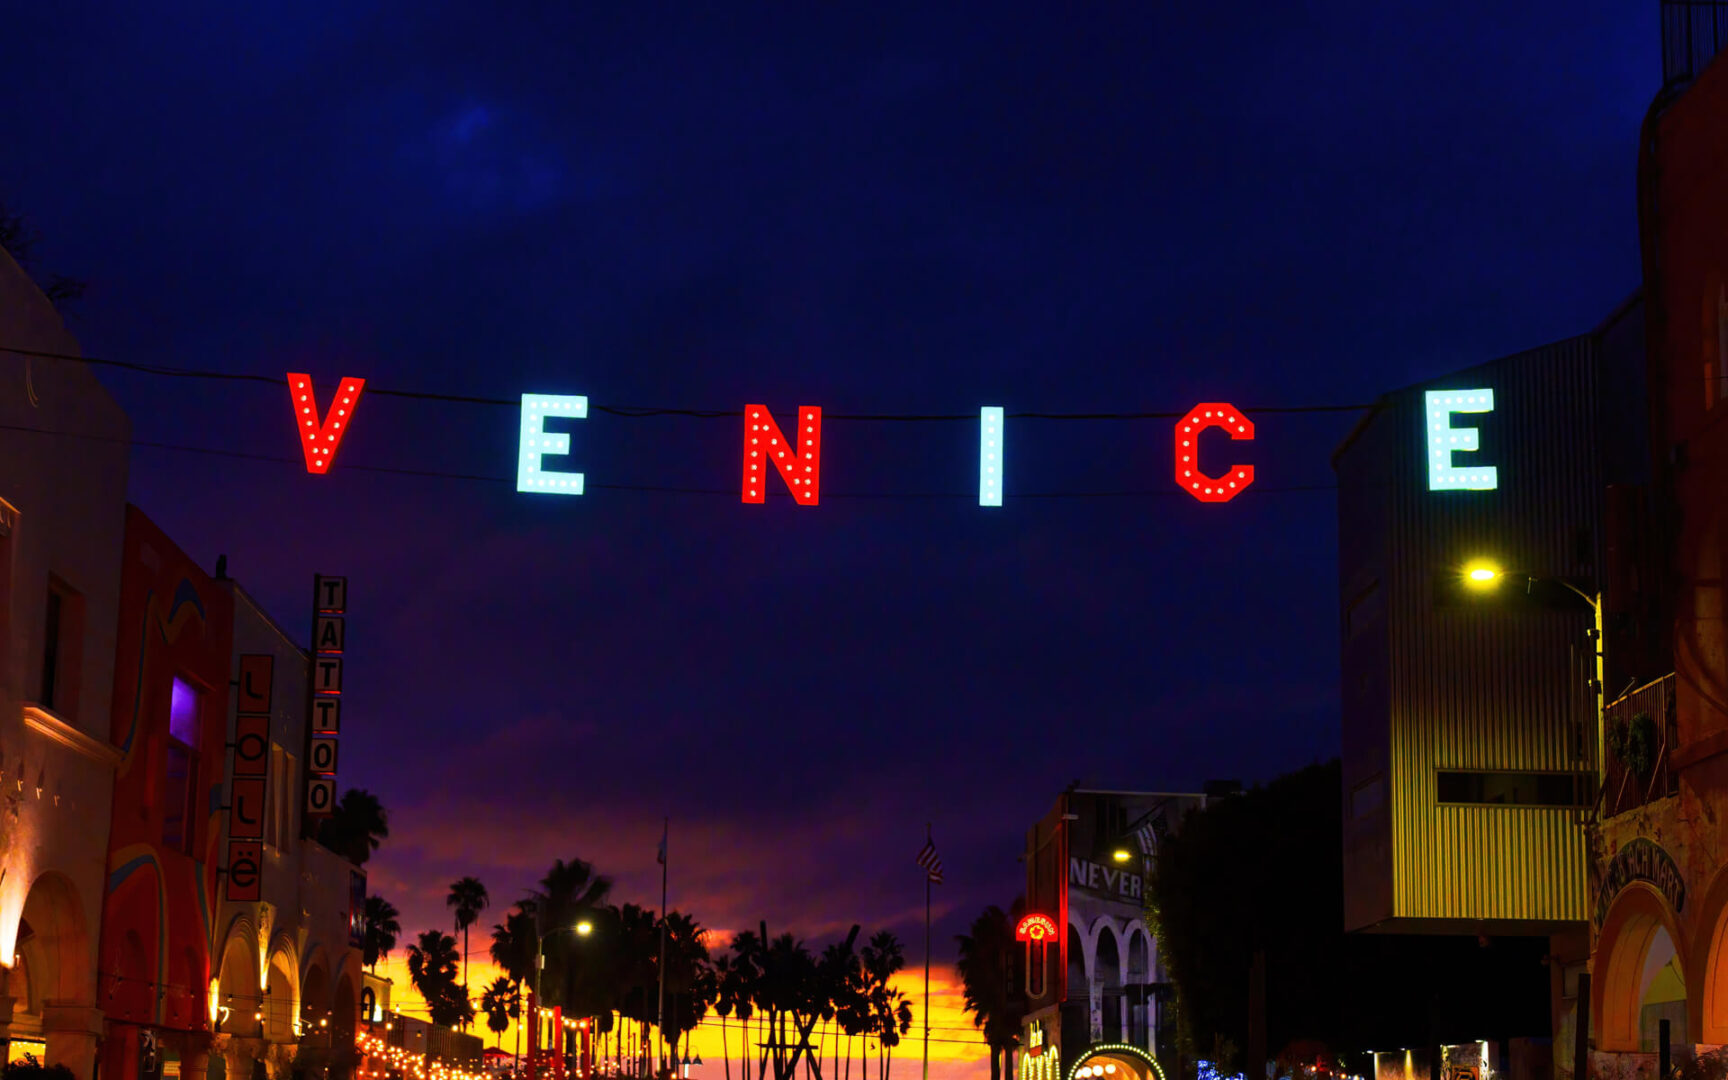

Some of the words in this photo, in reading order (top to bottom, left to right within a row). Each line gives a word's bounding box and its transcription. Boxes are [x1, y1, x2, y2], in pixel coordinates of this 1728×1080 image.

[287, 372, 1498, 507] VENICE
[311, 581, 340, 809] TATTOO
[1070, 857, 1142, 900] NEVER
